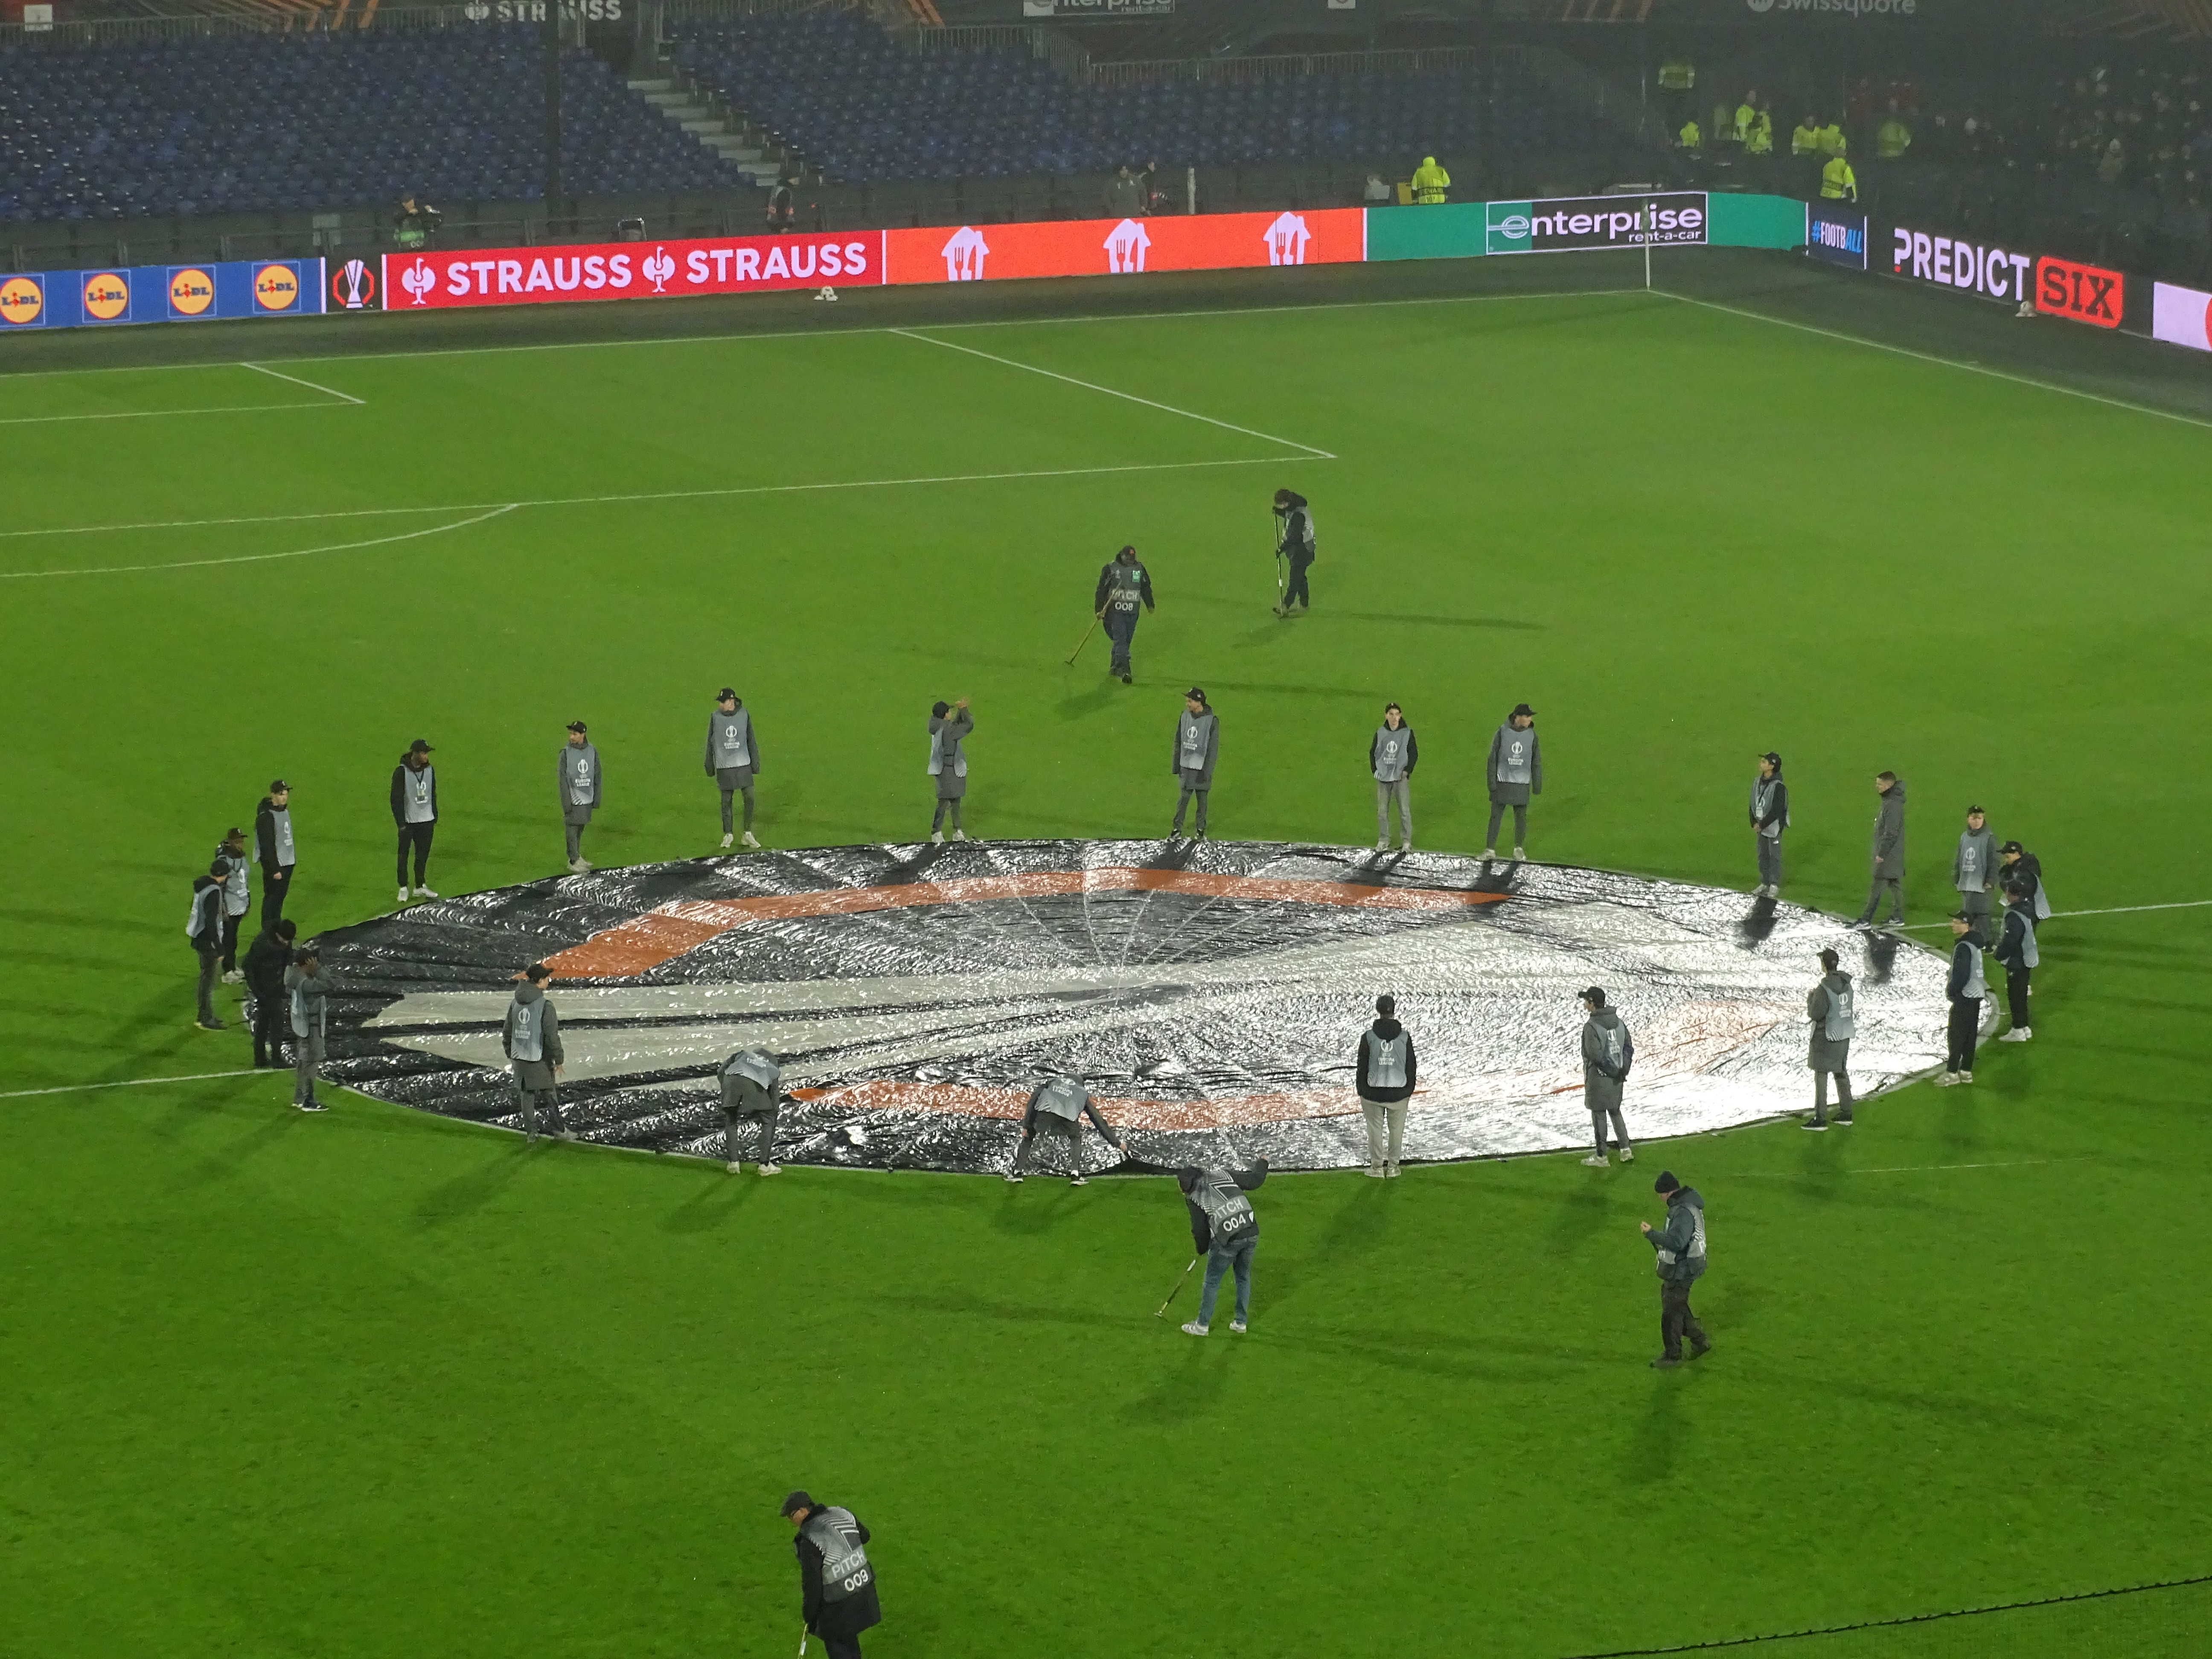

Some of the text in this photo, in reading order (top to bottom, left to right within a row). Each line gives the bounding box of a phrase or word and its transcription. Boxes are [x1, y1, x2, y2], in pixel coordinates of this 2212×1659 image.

[1811, 220, 1862, 253] #FOOTBALL
[447, 242, 867, 296] STRAUSS STRAUSS
[1894, 227, 2114, 320] PREDICT SIX
[1115, 602, 1133, 611] 008
[1216, 1198, 1244, 1219] ITCH
[1223, 1213, 1246, 1232] 004
[832, 1550, 865, 1578] PITCH
[844, 1569, 868, 1592] 009
